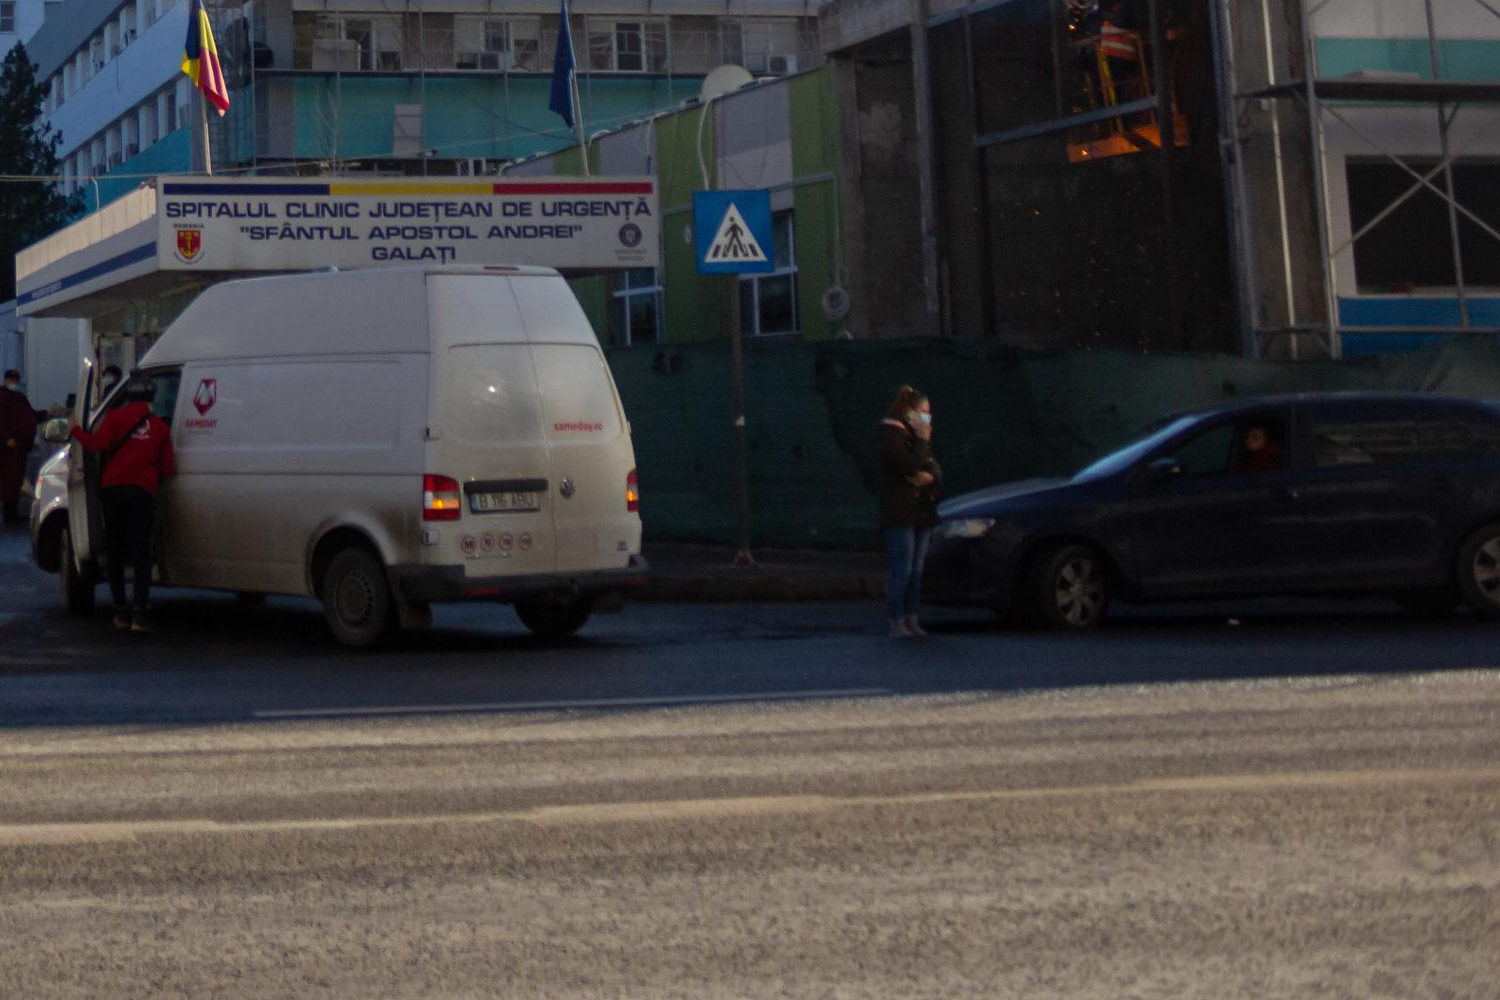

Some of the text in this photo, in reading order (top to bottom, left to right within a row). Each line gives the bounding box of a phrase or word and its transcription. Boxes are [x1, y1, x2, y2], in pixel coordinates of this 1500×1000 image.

[166, 196, 651, 222] SPITALUL CLINIC JUDEȚEAN DE URGENȚĂ
[240, 223, 583, 240] "SFÂNTUL APOSTOL ANDREI"
[371, 246, 456, 264] GALAȚI
[553, 420, 605, 433] sameday.ro
